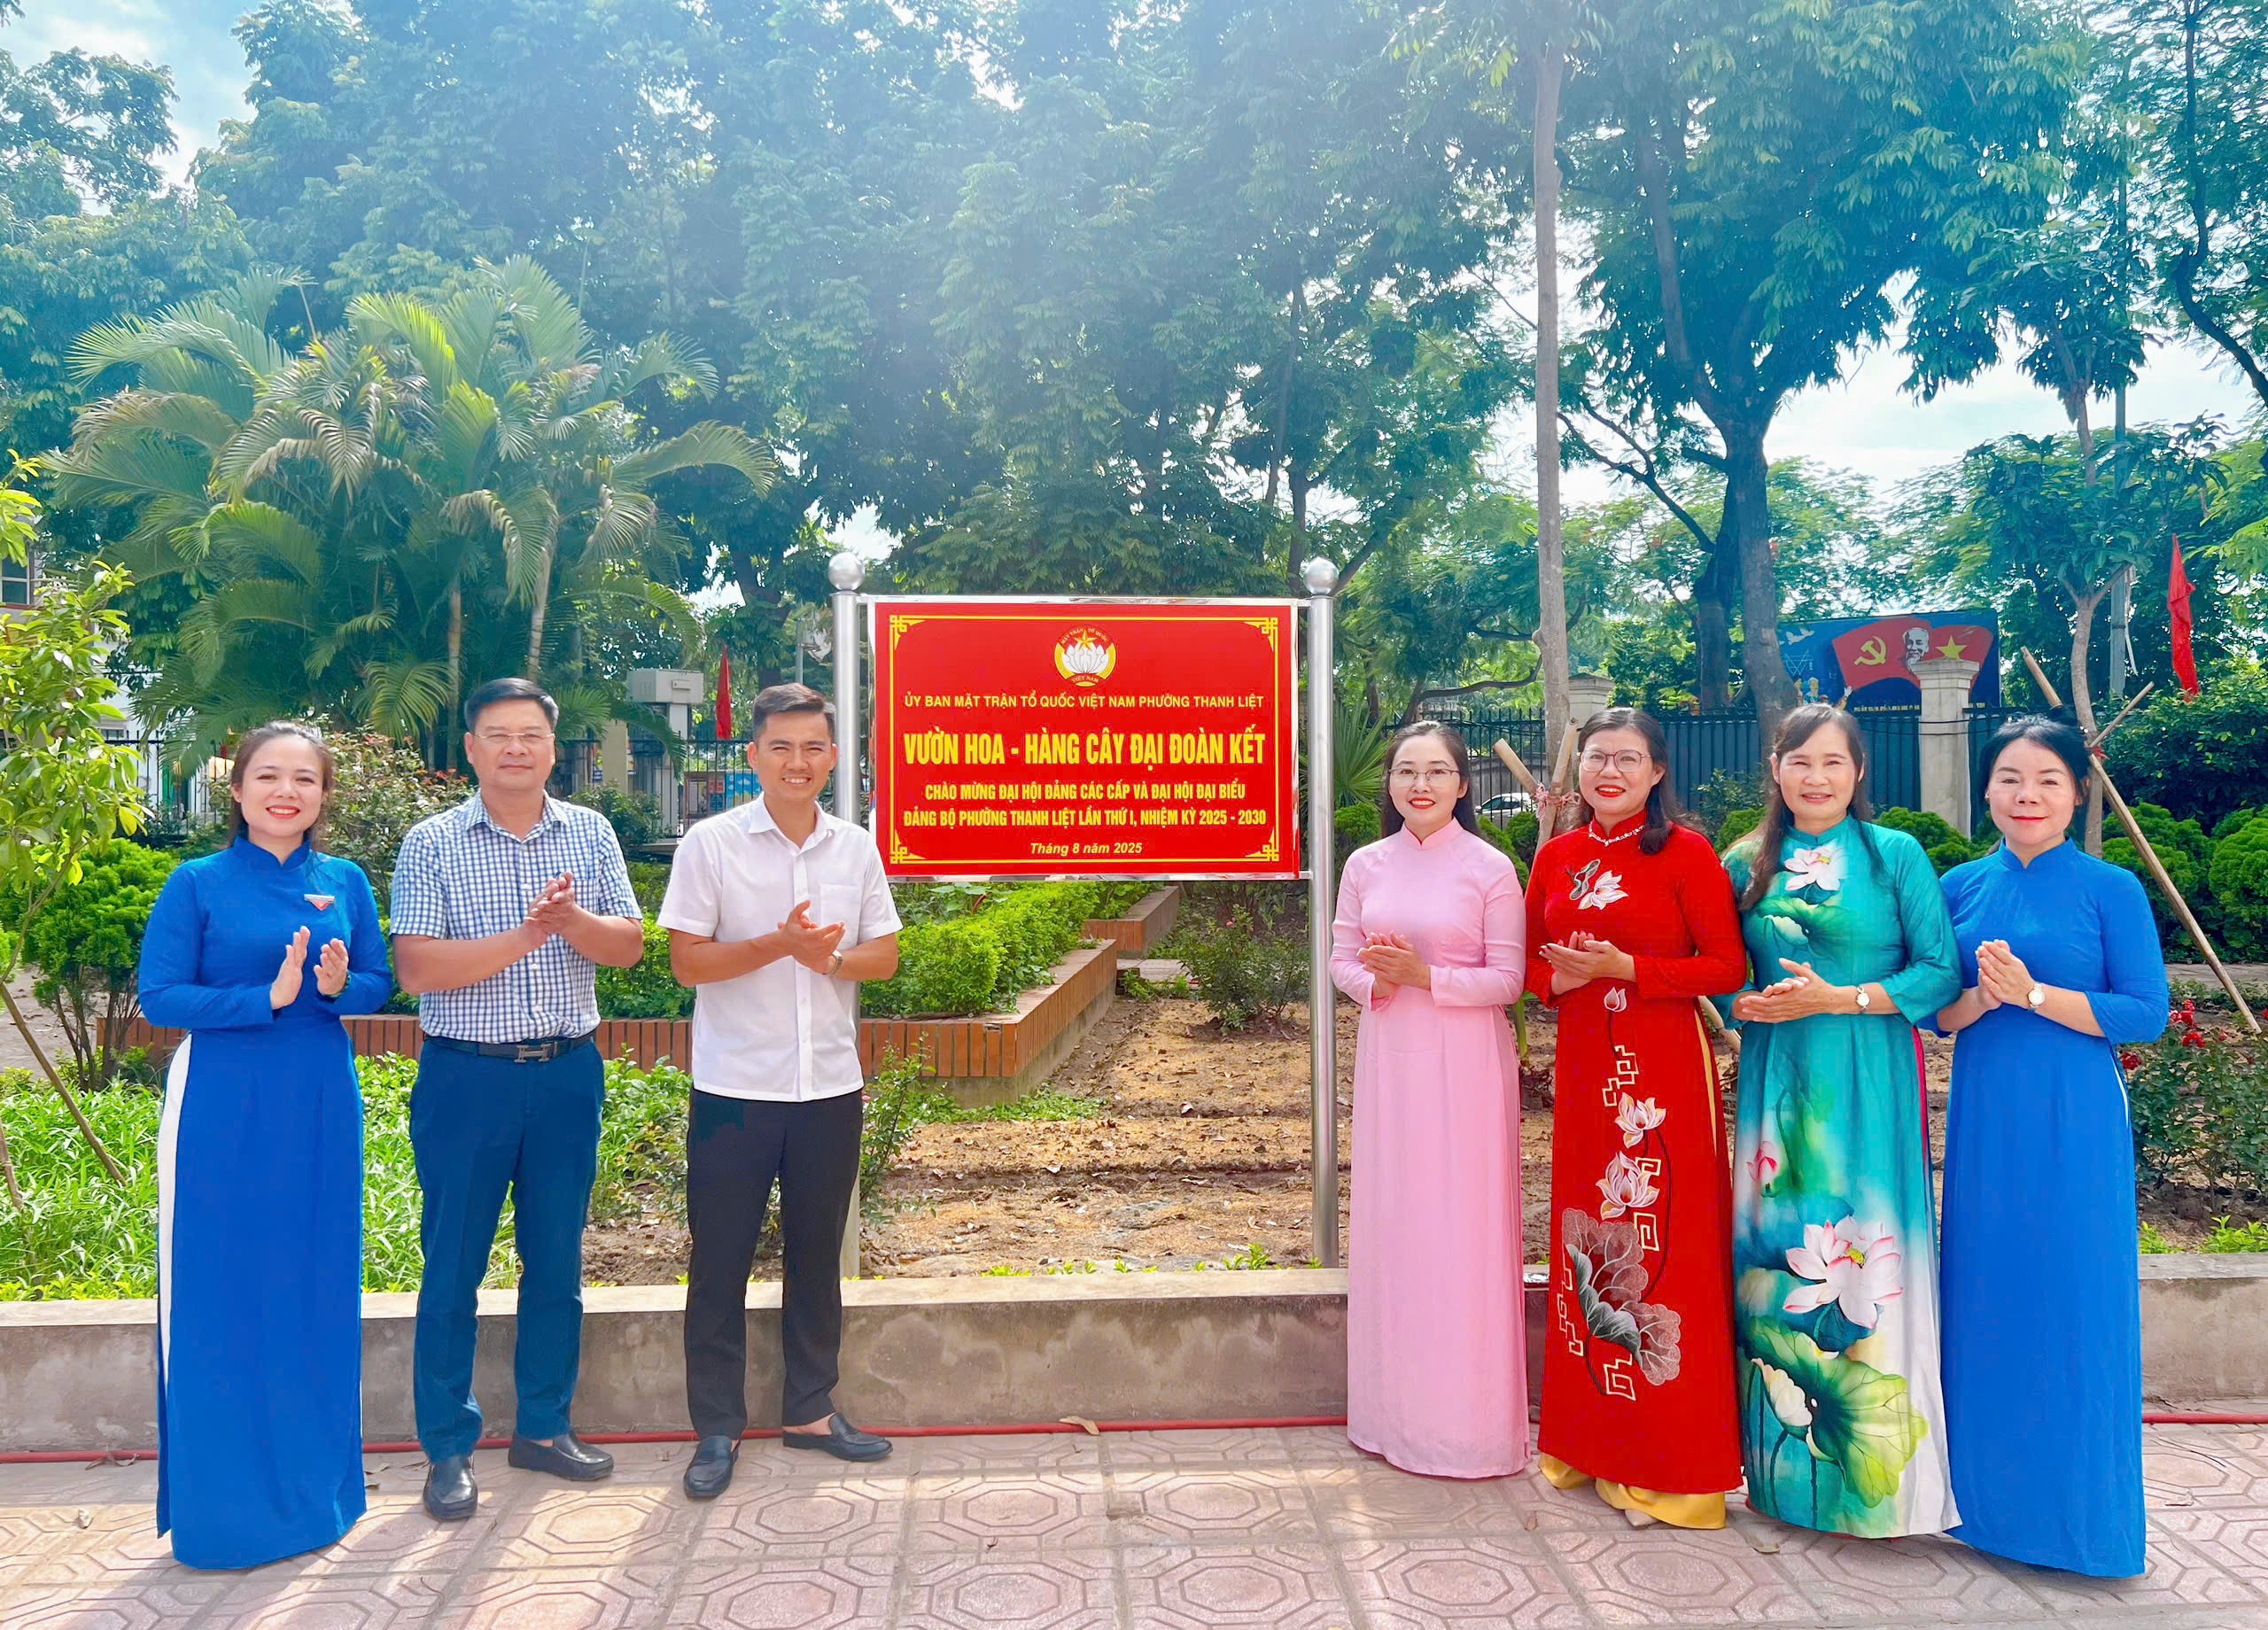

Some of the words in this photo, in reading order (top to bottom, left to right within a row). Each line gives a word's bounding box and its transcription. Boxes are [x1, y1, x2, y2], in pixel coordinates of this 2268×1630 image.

[905, 691, 921, 707] ỦY
[925, 695, 951, 707] BAN
[955, 694, 980, 709] MẶT
[983, 694, 1016, 709] TRẬN
[1021, 690, 1037, 707] TỔ
[1040, 692, 1075, 708] QUỐC
[1079, 694, 1106, 709] VIỆT
[1109, 695, 1135, 708] NAM
[1139, 694, 1190, 708] PHƯỜNG
[1193, 695, 1234, 708] THANH
[1239, 694, 1264, 709] LIỆT
[904, 726, 959, 765] VƯỜN
[965, 734, 1006, 765] HOA
[1025, 727, 1079, 765] HÀNG
[1086, 727, 1124, 765] CÂY
[1130, 734, 1163, 771] ĐẠI
[1169, 727, 1223, 764] ĐOÀN
[1230, 724, 1265, 764] KẾT
[925, 781, 957, 800] CHÀO
[960, 781, 996, 800] MỪNG
[999, 784, 1019, 803] ĐẠI
[1022, 781, 1042, 803] HỘI
[1045, 780, 1076, 800] ĐẢNG
[1080, 781, 1103, 800] CÁC
[1107, 780, 1130, 800] CẤP
[1133, 781, 1148, 799] VÀ
[1152, 784, 1170, 802] ĐẠI
[1174, 781, 1193, 802] HỘI
[1196, 784, 1216, 802] ĐẠI
[1219, 778, 1245, 799] BIỂU
[904, 806, 936, 826] ĐẢNG
[940, 808, 956, 829] BỘ
[959, 807, 1006, 826] PHƯỜNG
[1010, 810, 1049, 826] THANH
[1052, 808, 1076, 828] LIỆT
[1079, 805, 1101, 826] LẦN
[1105, 807, 1128, 826] THỨ
[1130, 810, 1138, 827] I,
[1141, 807, 1178, 828] NHIỆM
[1182, 807, 1196, 825] KỲ
[1200, 810, 1227, 825] 2025
[1239, 810, 1267, 825] 2030
[1031, 843, 1068, 857] Tháng
[1072, 843, 1080, 853] 8
[1084, 843, 1109, 853] năm
[1114, 842, 1143, 853] 2025
